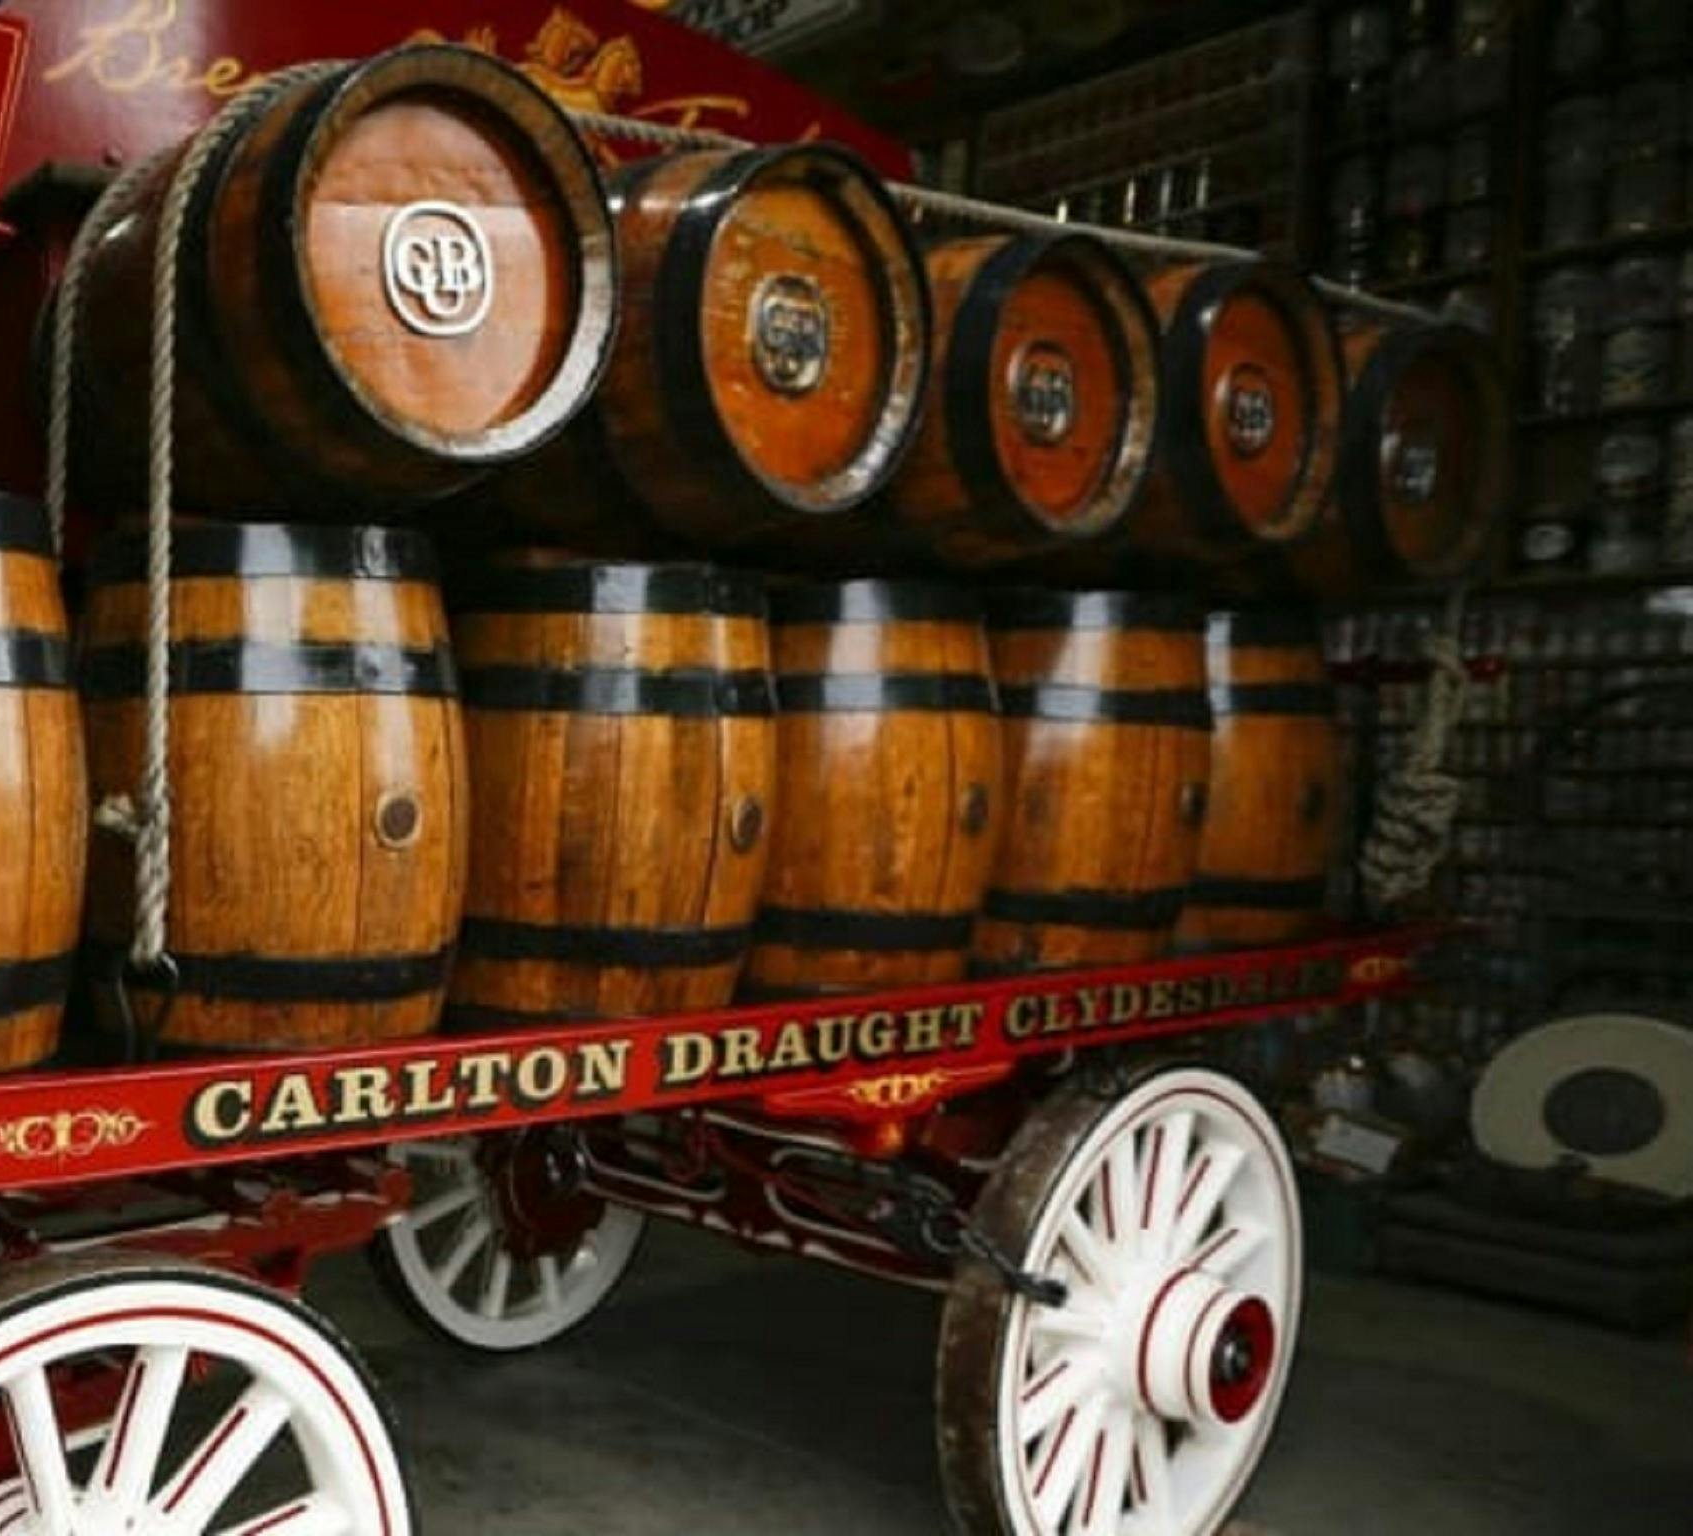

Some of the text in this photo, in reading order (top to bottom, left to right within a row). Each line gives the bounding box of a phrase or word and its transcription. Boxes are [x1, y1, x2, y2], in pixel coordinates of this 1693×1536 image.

[43, 0, 267, 96] Bre
[191, 1038, 635, 1144] CARLTON
[663, 1002, 985, 1084] DRAUGHT
